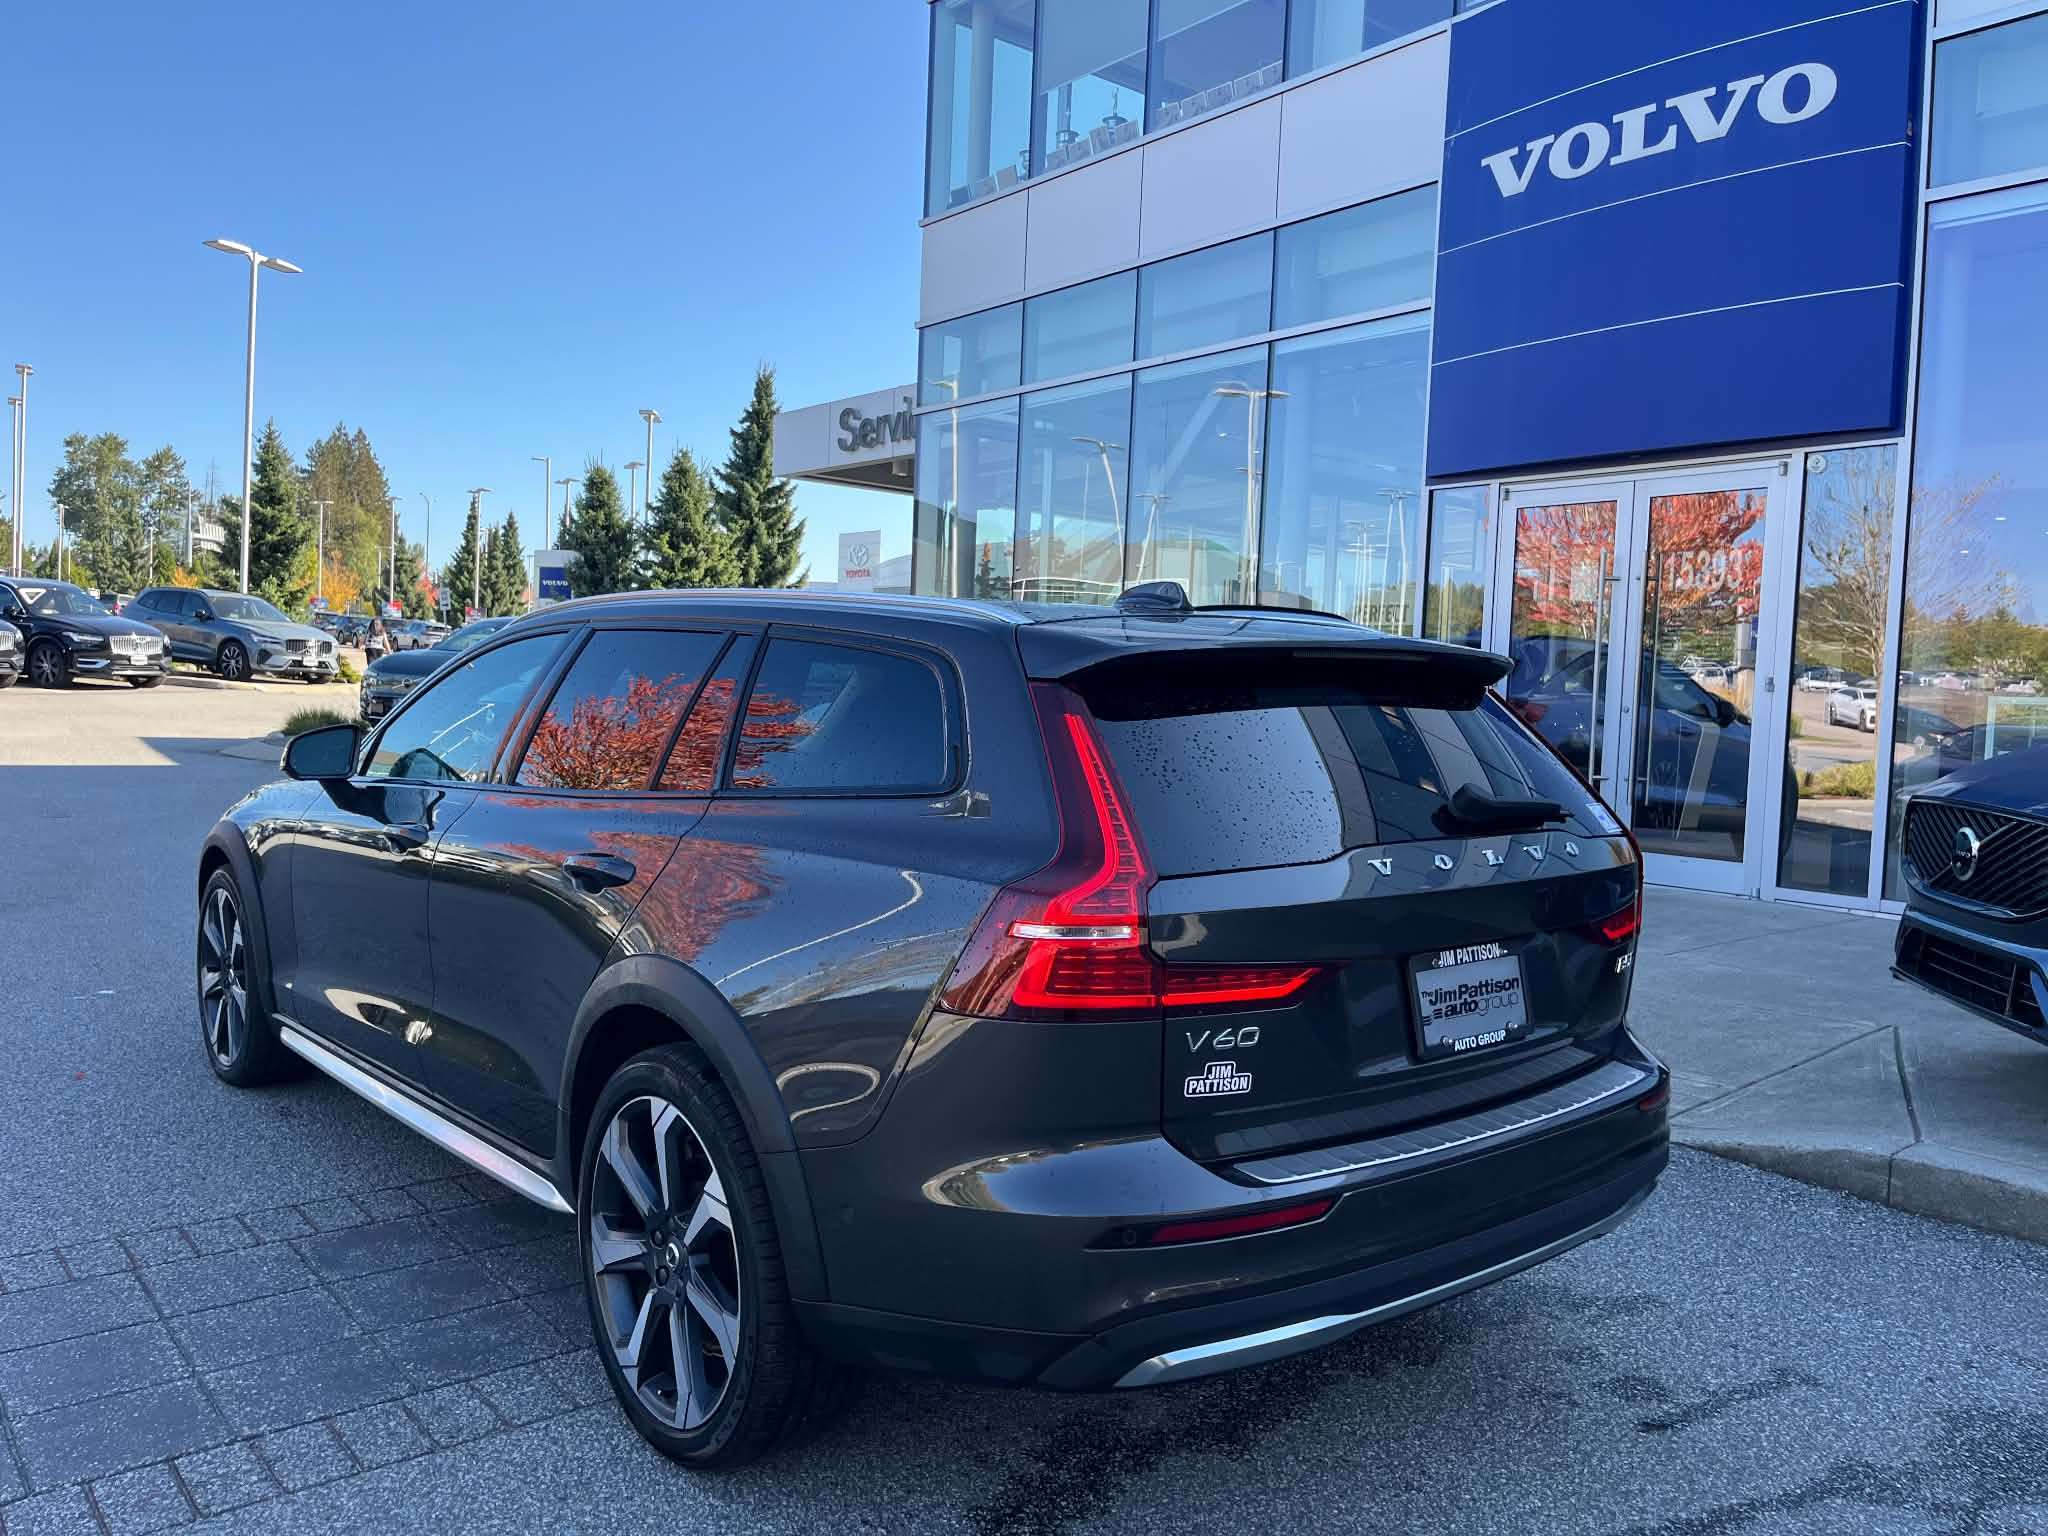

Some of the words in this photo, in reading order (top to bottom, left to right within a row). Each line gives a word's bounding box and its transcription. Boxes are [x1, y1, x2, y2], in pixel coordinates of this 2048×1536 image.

[1481, 62, 1838, 198] VOLVO
[1367, 841, 1580, 876] VOLVO
[1440, 949, 1456, 967] JIM
[1457, 943, 1500, 964] PATTISON
[1185, 1026, 1260, 1052] V60
[1454, 1035, 1477, 1052] AUTO
[1478, 1029, 1507, 1046] GROUP
[1208, 1065, 1232, 1079] JIM
[1188, 1076, 1249, 1094] PATTISON
